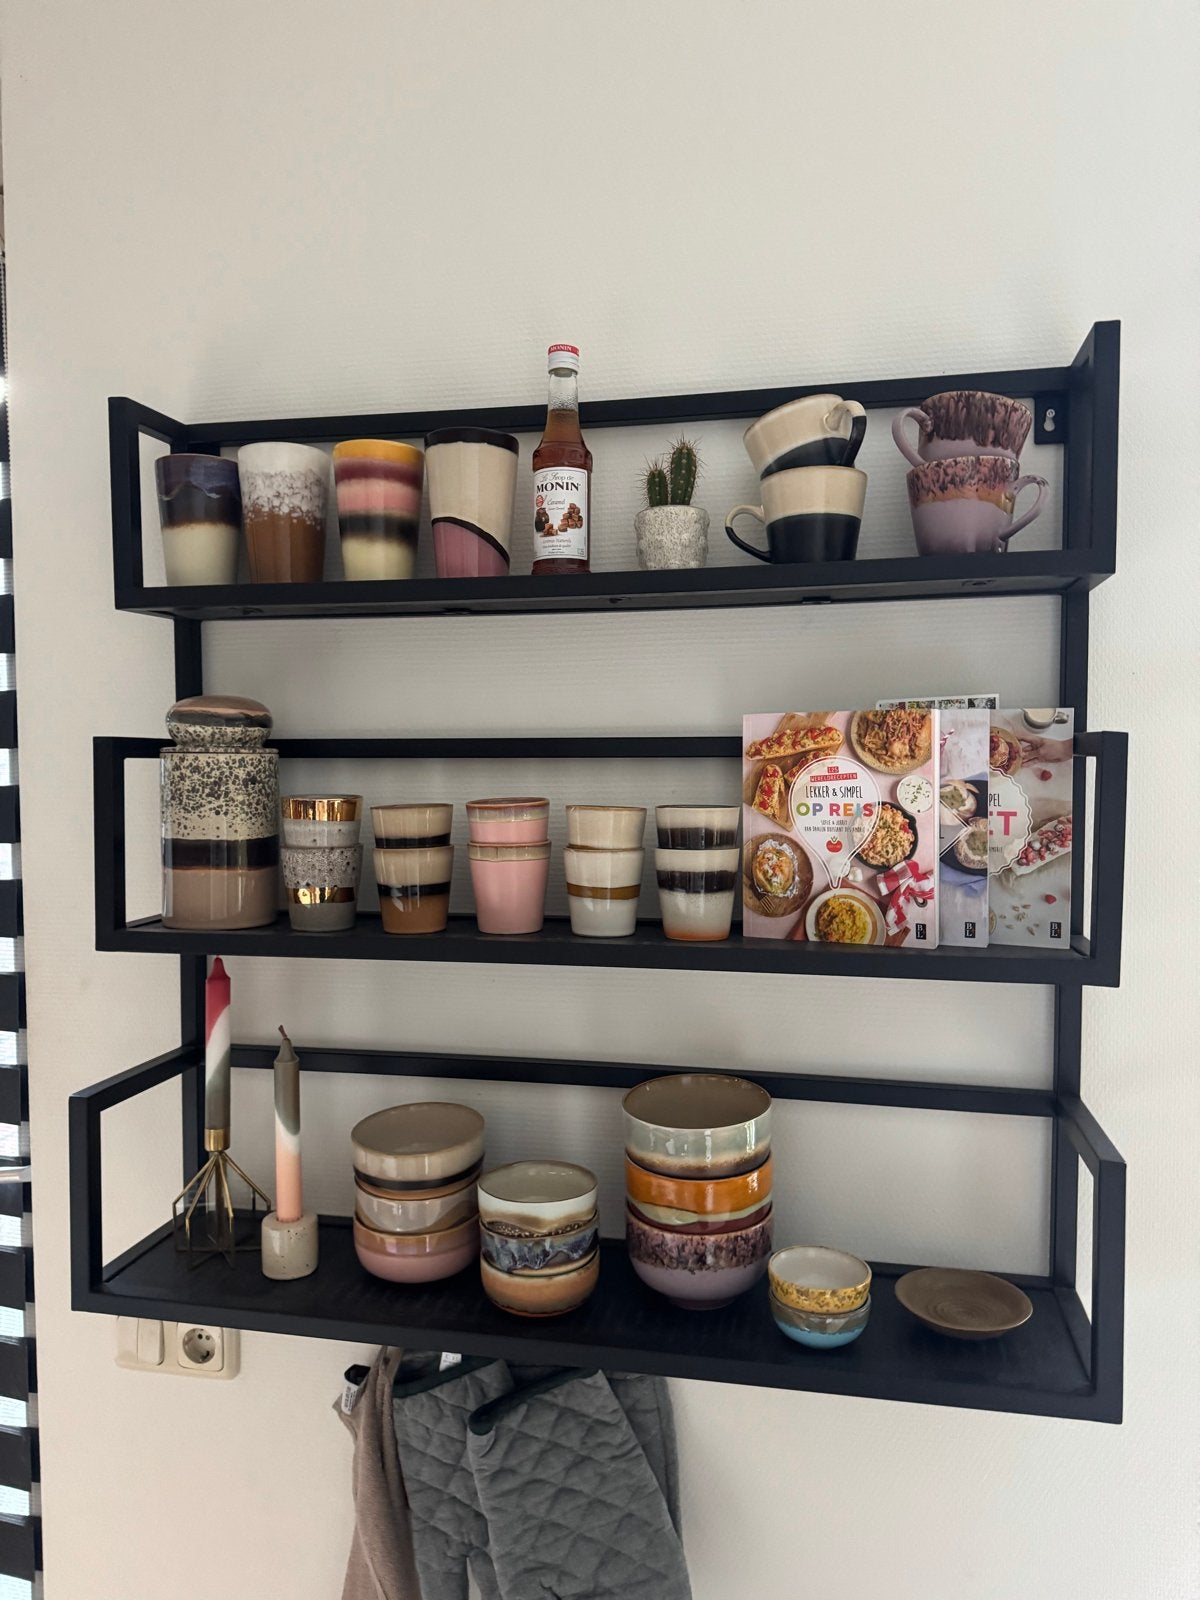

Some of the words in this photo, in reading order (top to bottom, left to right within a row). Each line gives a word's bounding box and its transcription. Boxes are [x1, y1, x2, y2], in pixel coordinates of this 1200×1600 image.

[536, 481, 579, 494] MONIN
[805, 785, 830, 799] LEKKER
[832, 787, 838, 797] &
[839, 785, 863, 799] SIMPEL
[796, 802, 823, 817] OP
[829, 802, 874, 817] REIS
